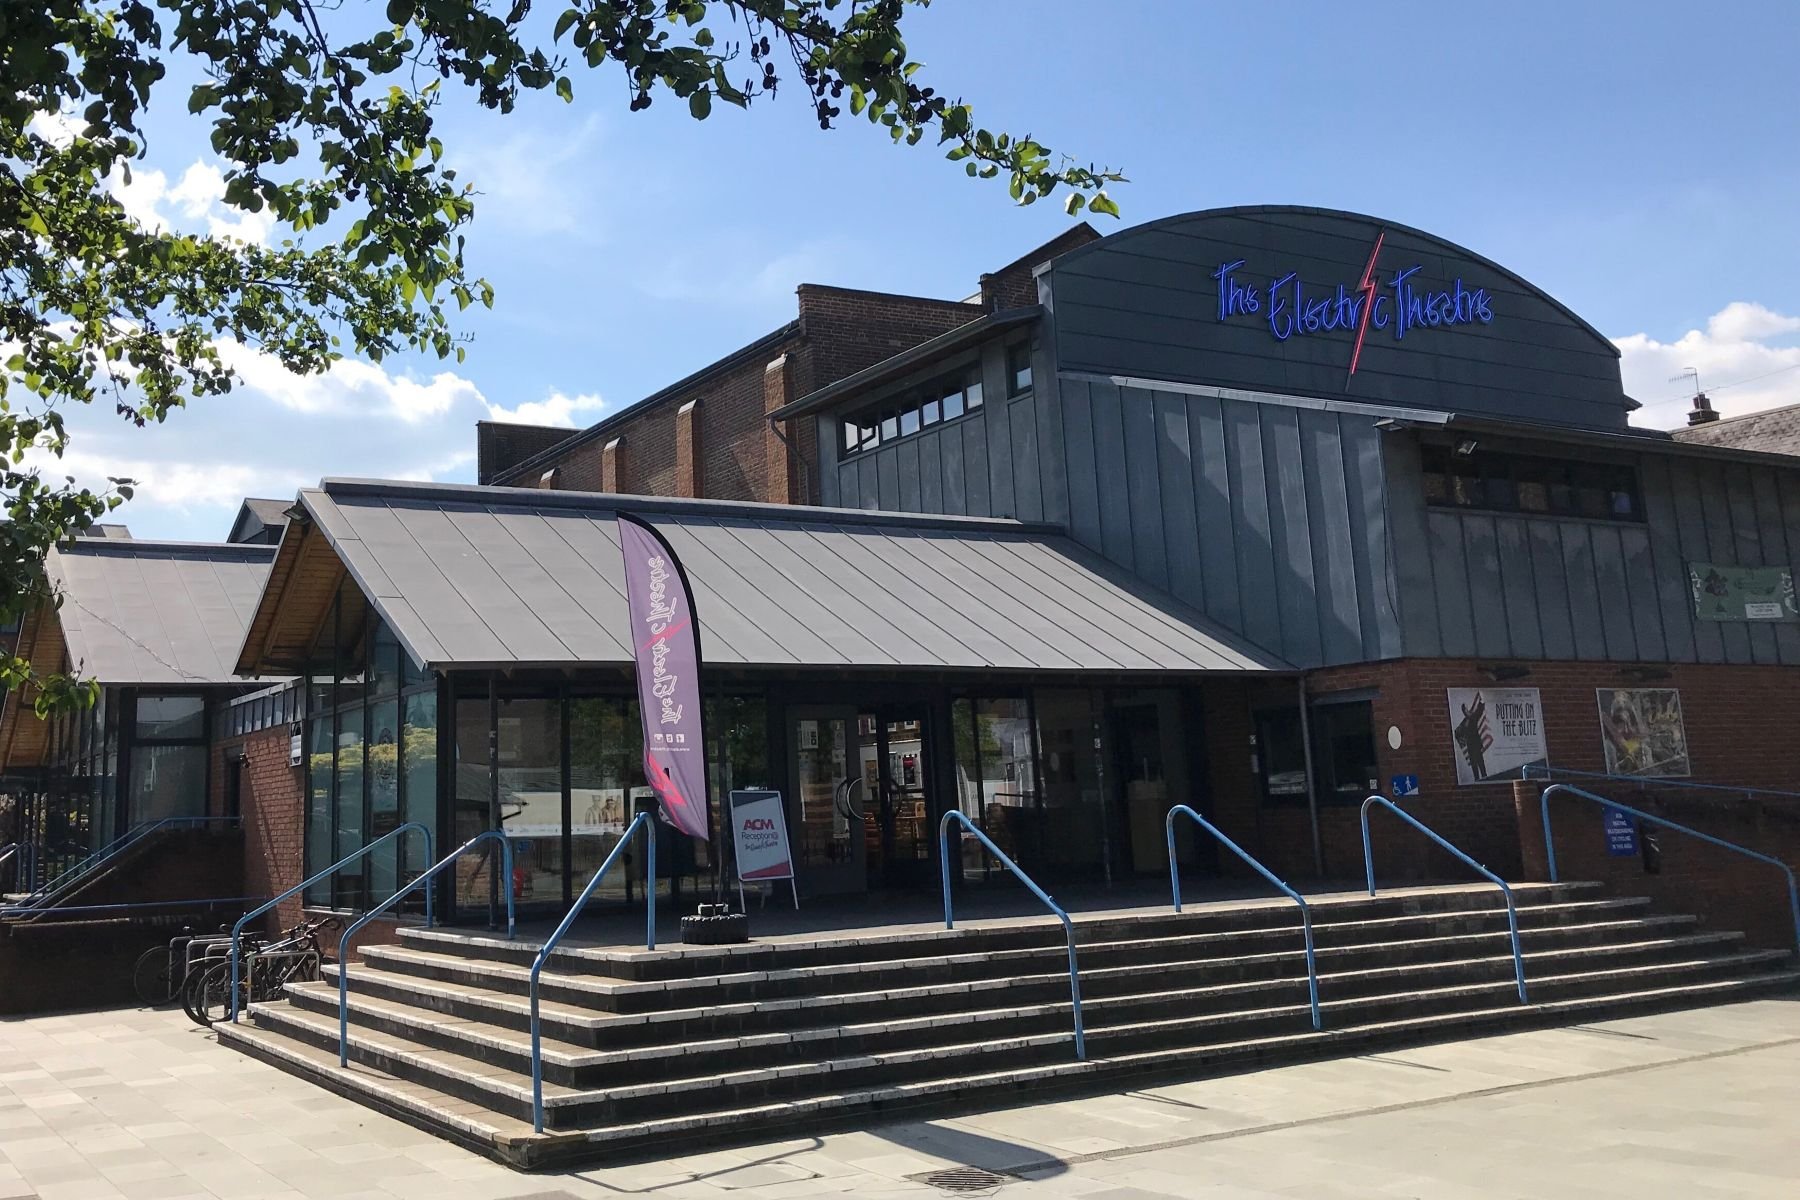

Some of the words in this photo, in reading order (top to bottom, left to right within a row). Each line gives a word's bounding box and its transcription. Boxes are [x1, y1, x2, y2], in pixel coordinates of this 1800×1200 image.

[1211, 259, 1260, 320] The
[1389, 265, 1493, 339] Theatre
[1495, 703, 1523, 719] PUTTING
[1525, 703, 1535, 719] ON
[1502, 720, 1516, 736] THE
[1519, 720, 1537, 736] BLITZ
[743, 818, 775, 831] ACM
